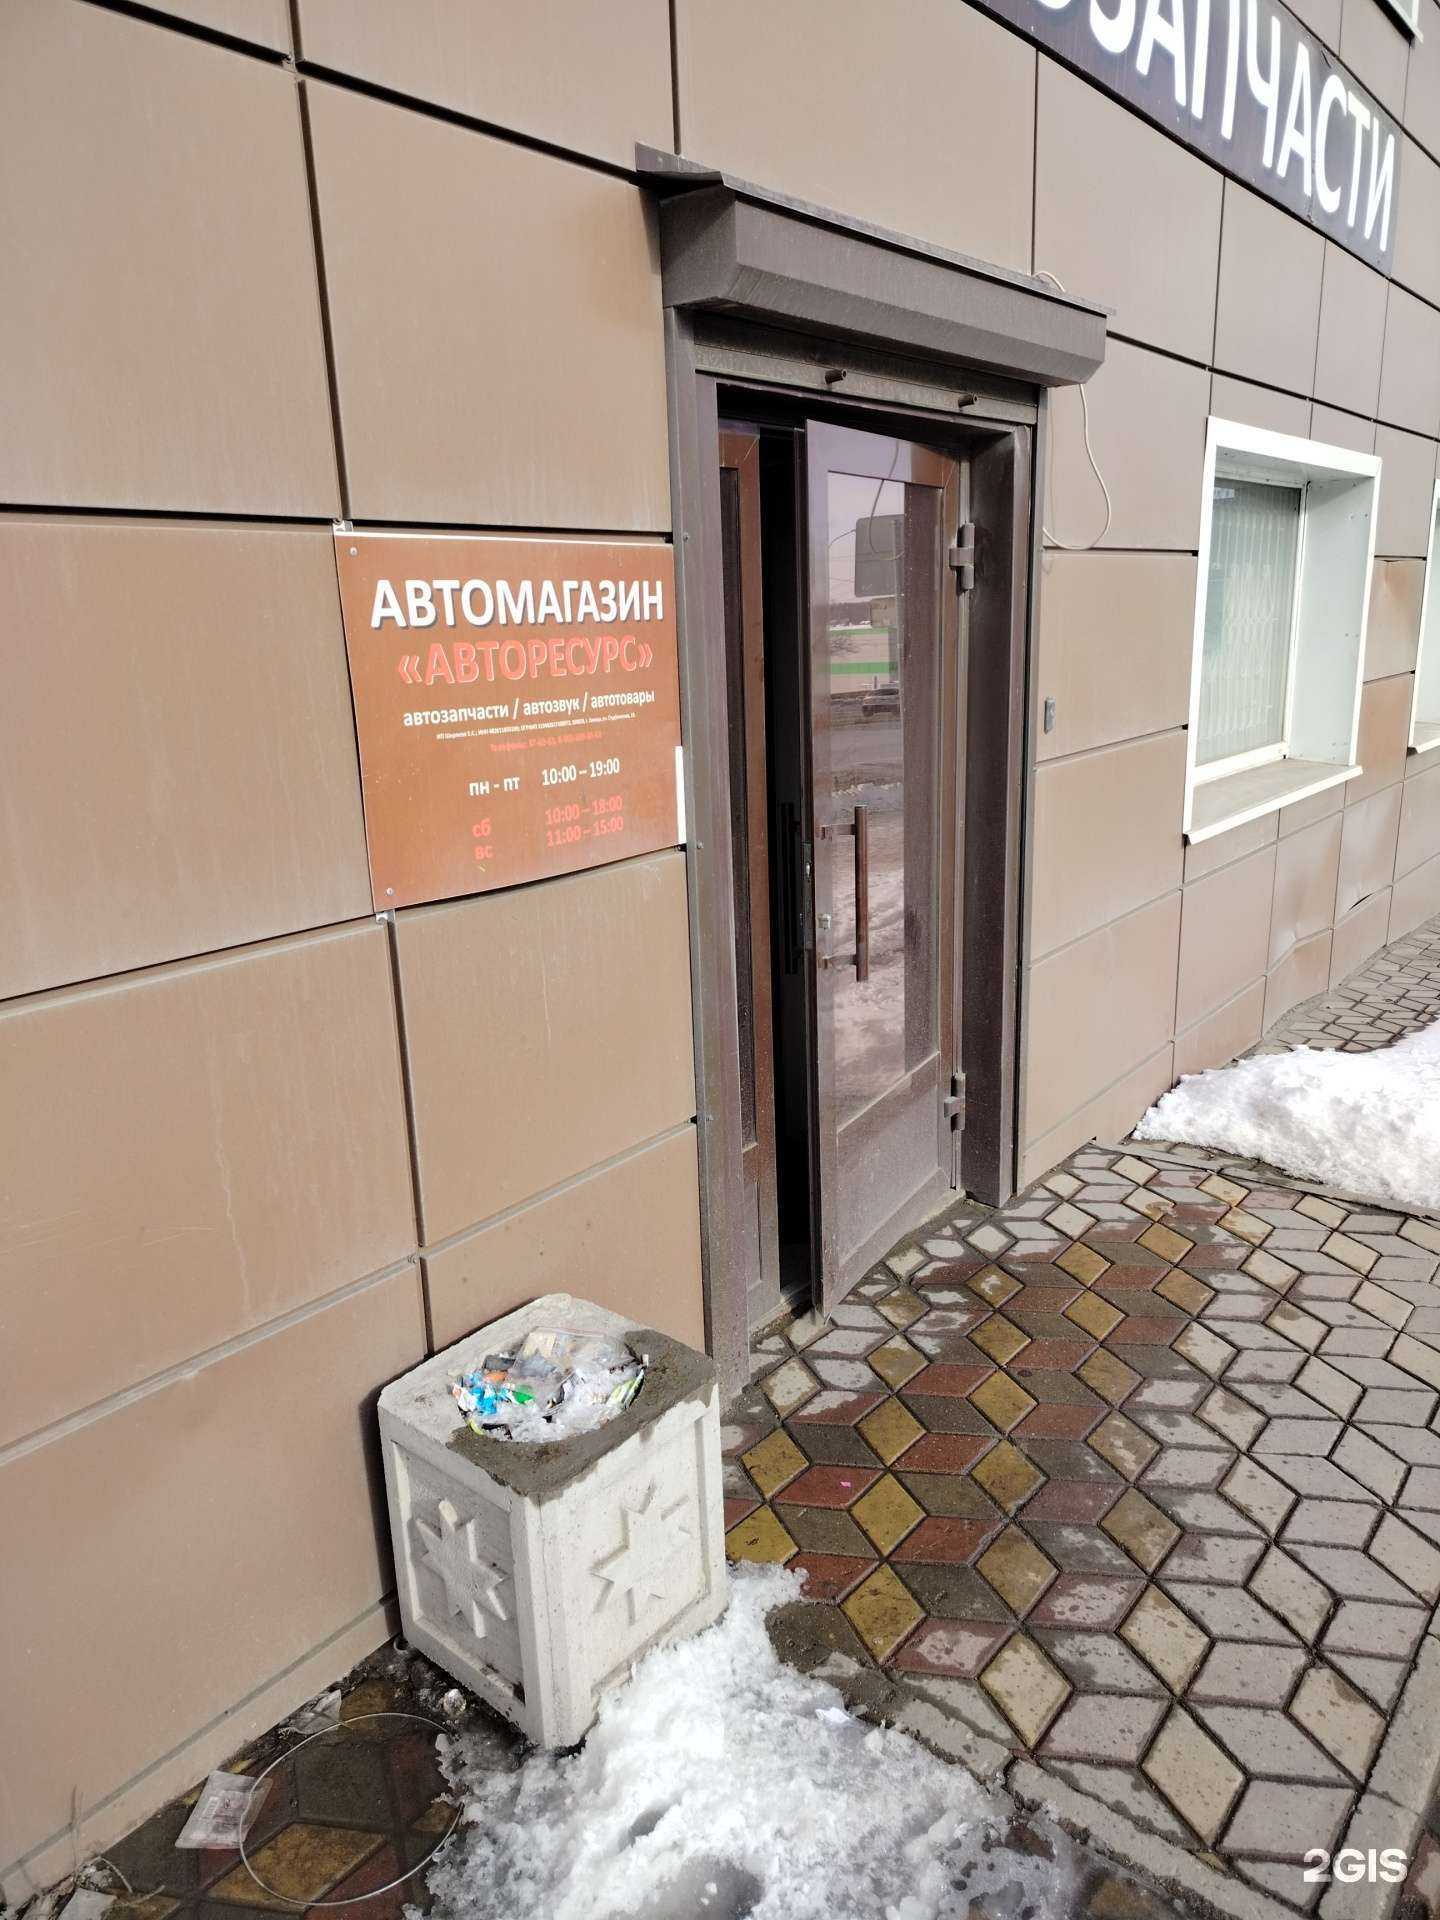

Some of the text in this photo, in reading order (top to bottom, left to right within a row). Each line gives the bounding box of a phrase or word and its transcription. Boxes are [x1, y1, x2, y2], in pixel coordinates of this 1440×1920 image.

[1031, 0, 1397, 252] АПЧАСТИ
[370, 579, 664, 629] АВТОМАГАЗИН
[398, 634, 654, 687] «АВТОРЕСУРС»
[403, 702, 509, 727] автозапчасти
[523, 696, 580, 718] автозвук
[591, 690, 656, 711] автотовары
[469, 781, 490, 796] пн
[503, 777, 521, 792] пт
[542, 765, 577, 786] 10:00
[589, 758, 620, 778] 19:00
[472, 818, 492, 838] сб
[545, 804, 580, 825] 10:00
[593, 796, 623, 816] 18:00
[475, 846, 493, 860] вс
[546, 826, 581, 847] 11:00
